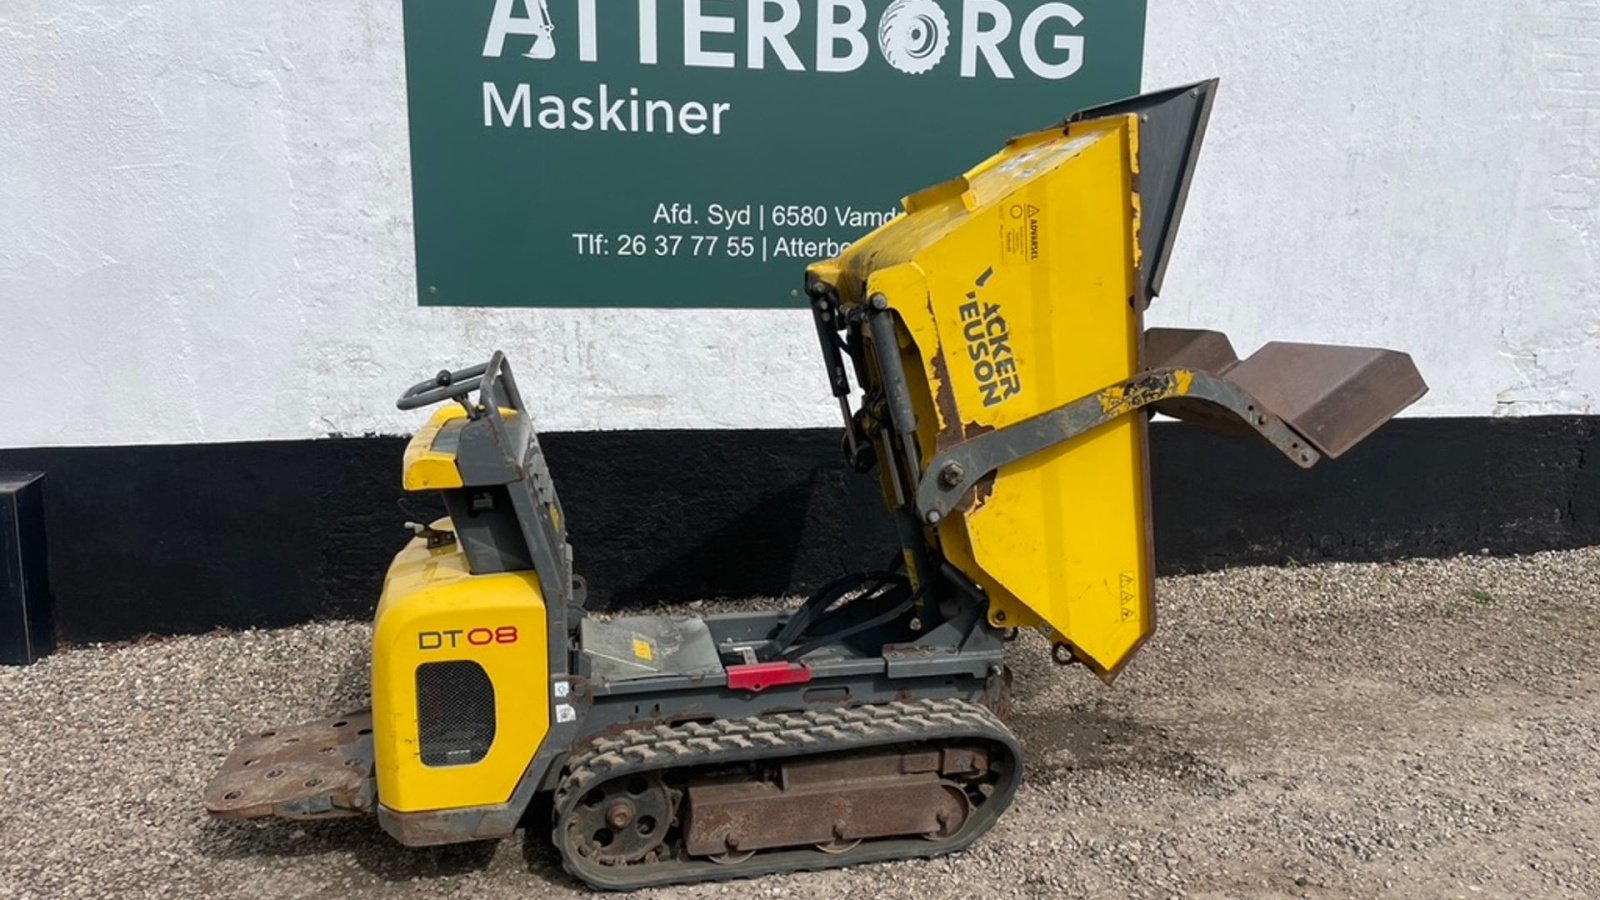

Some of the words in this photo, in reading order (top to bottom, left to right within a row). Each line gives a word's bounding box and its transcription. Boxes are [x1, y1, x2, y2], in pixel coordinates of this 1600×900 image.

[481, 0, 1085, 80] ATTERBORG
[482, 81, 731, 135] Maskiner
[653, 203, 699, 225] Afd.
[707, 204, 751, 231] Syd
[771, 205, 828, 227] 6580
[834, 206, 904, 227] Vamd
[1030, 218, 1039, 260] ADVARSEL
[572, 233, 608, 255] Tlf:
[617, 234, 647, 256] 26
[654, 235, 683, 256] 37
[690, 235, 718, 256] 77
[726, 236, 755, 257] 55
[959, 290, 1002, 407] EUSON
